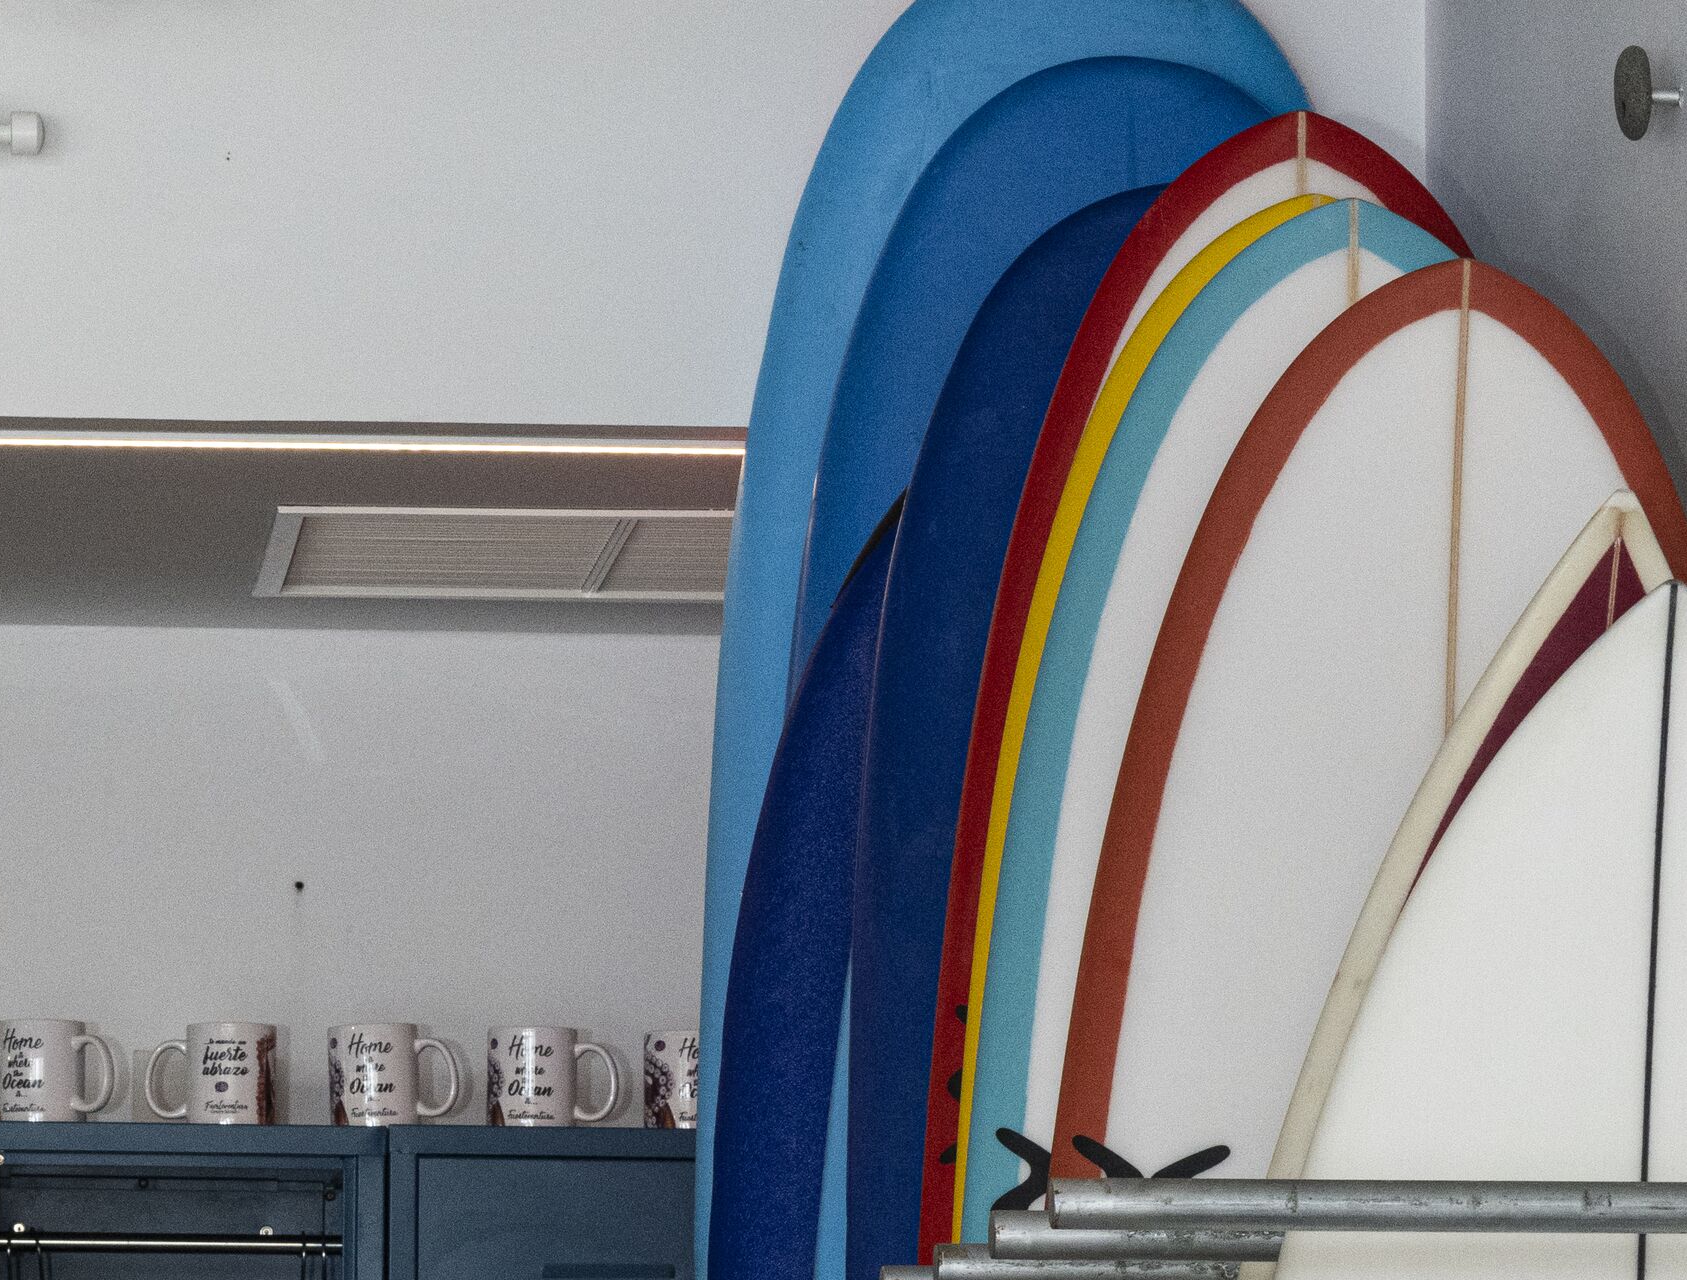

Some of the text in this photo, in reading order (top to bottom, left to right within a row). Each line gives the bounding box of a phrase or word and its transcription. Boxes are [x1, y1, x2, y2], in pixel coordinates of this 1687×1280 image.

[3, 1028, 44, 1053] Home
[347, 1033, 395, 1058] Home
[203, 1045, 249, 1065] fuerte
[202, 1060, 250, 1076] abrazo
[2, 1072, 45, 1090] Ocean
[349, 1078, 396, 1095] Ocan
[508, 1079, 555, 1097] Ocan
